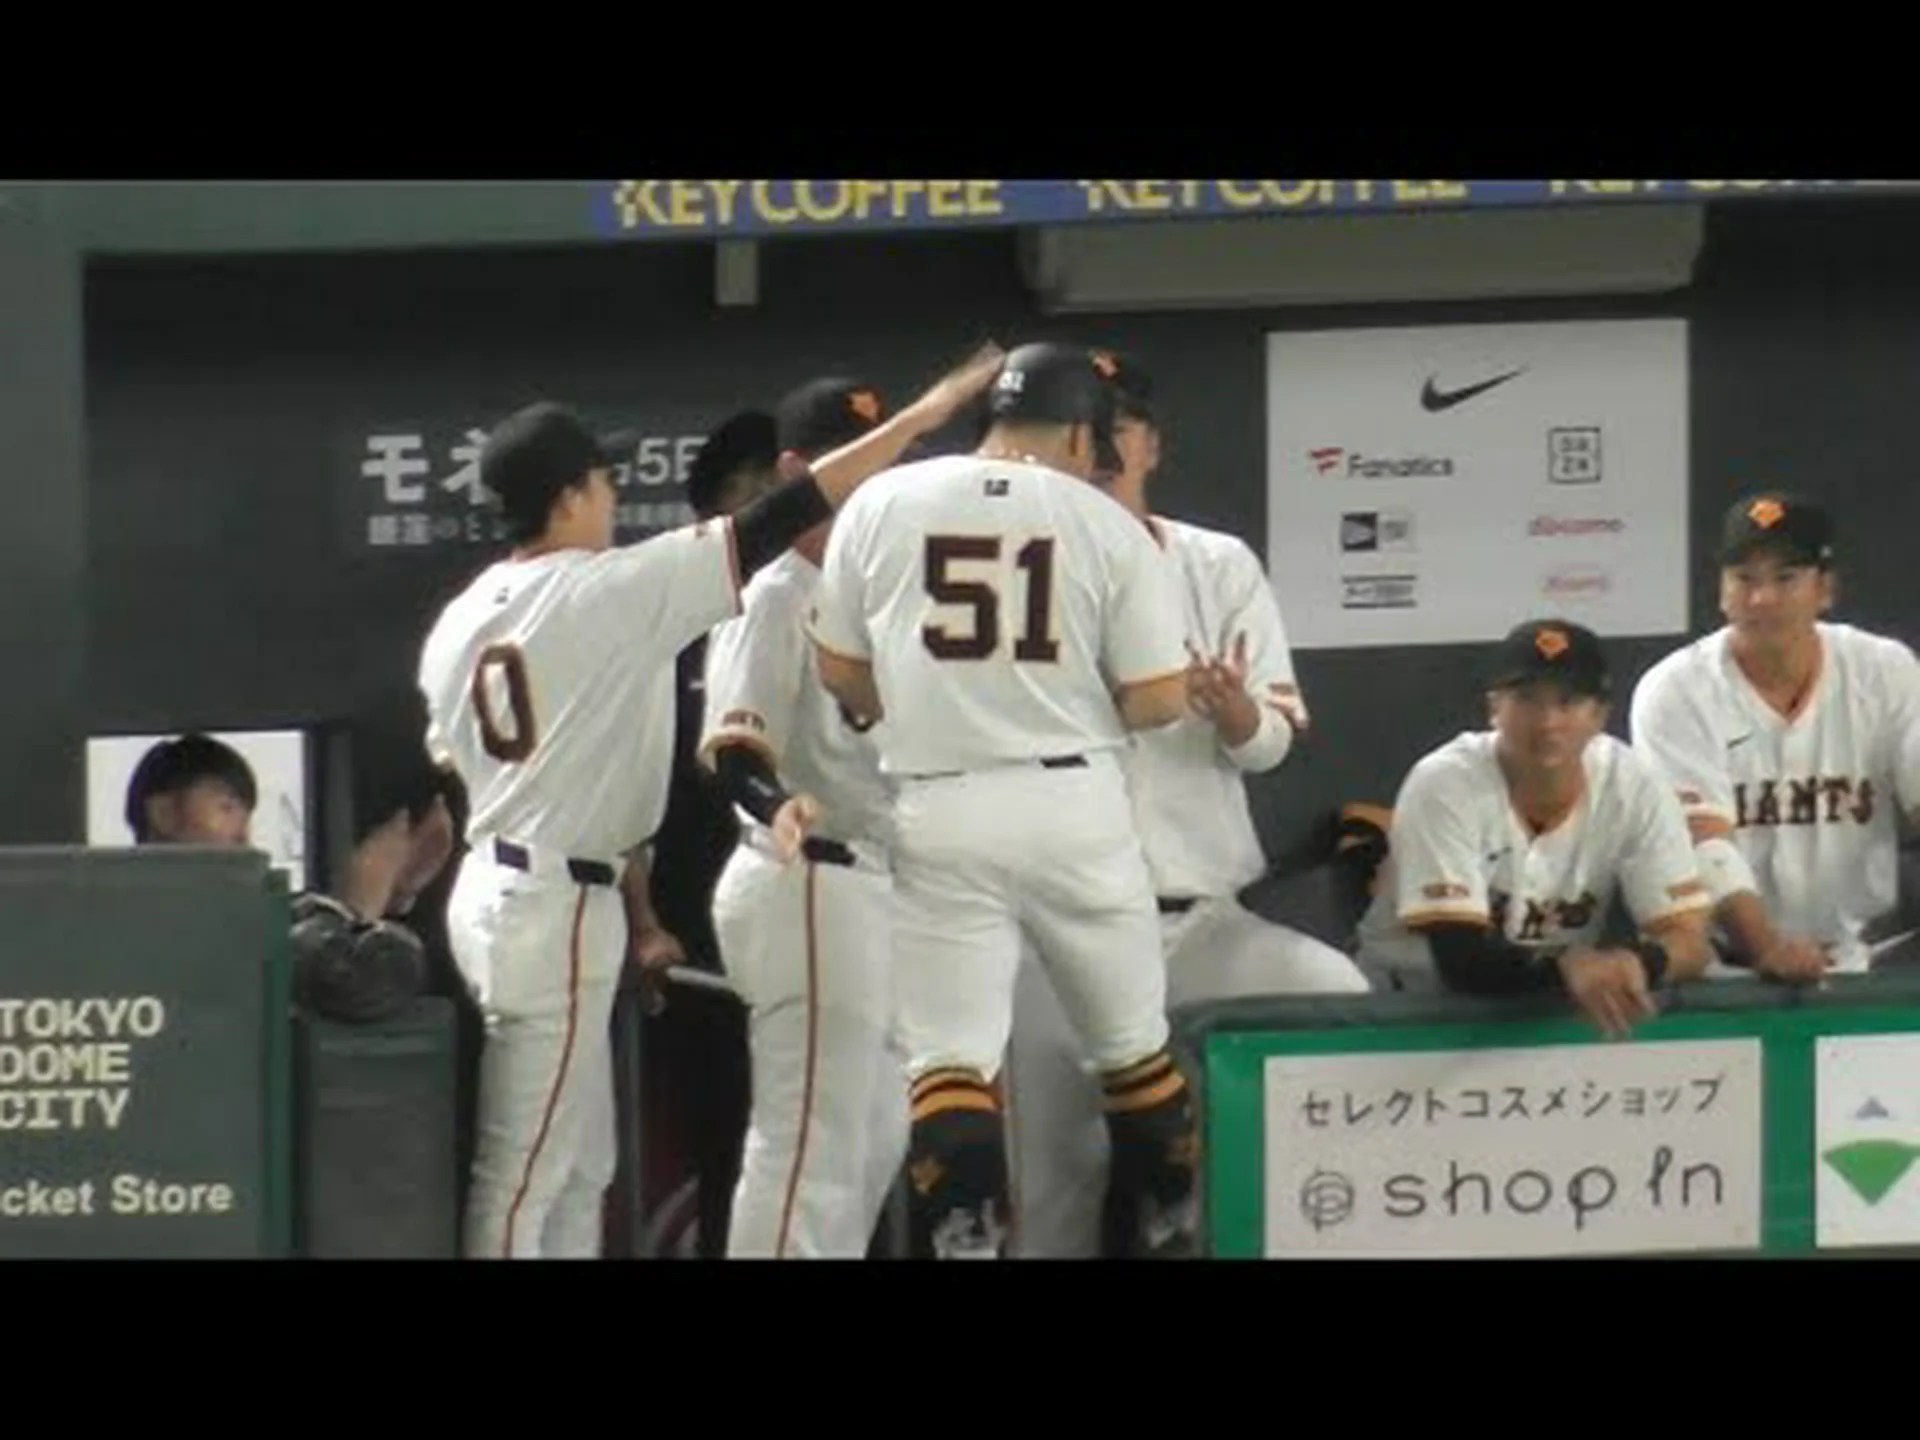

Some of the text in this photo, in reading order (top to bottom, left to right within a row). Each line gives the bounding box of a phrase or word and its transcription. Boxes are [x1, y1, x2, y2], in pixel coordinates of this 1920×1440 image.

[922, 535, 1059, 662] 51
[472, 642, 537, 764] 0
[0, 996, 164, 1039] TOKYO
[0, 1042, 131, 1083] DOME
[0, 1087, 130, 1129] CITY
[111, 1173, 234, 1214] Store
[1383, 1160, 1618, 1231] shop
